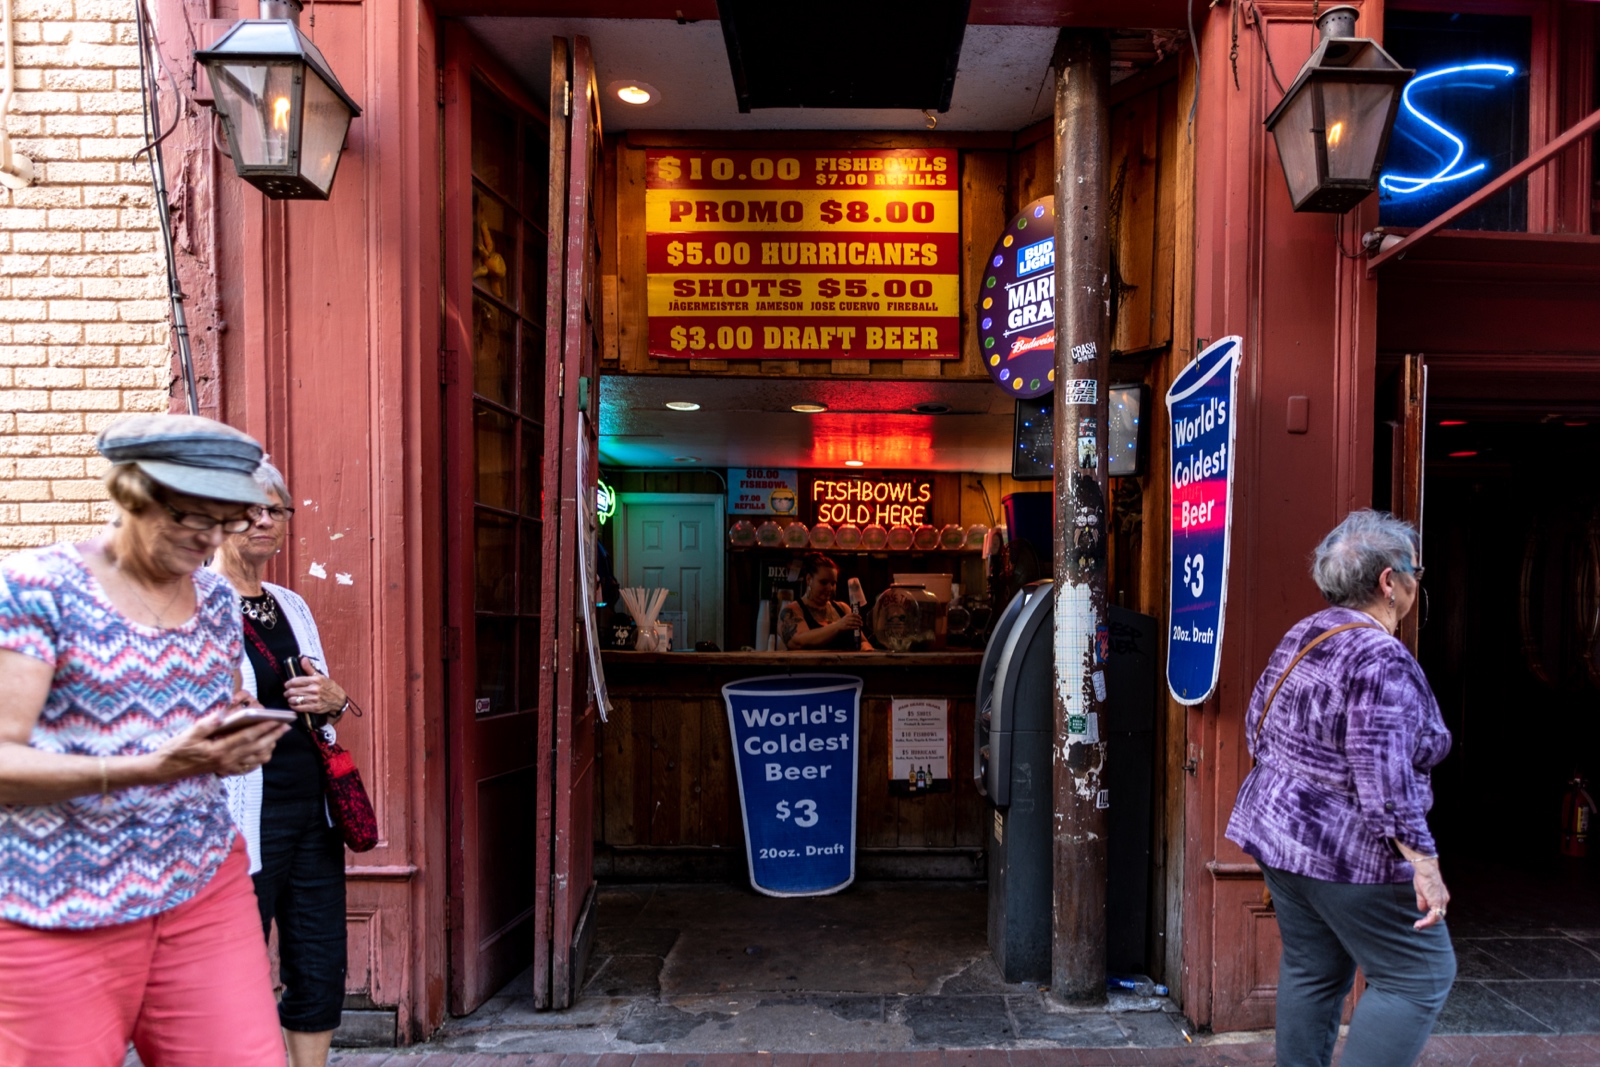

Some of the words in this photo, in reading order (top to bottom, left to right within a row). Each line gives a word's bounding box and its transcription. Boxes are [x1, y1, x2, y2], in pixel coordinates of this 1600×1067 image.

[658, 156, 800, 181] $10.00
[815, 157, 947, 172] FISHBOWLS
[816, 174, 868, 186] $7.00
[874, 174, 947, 186] REFILLS
[669, 200, 803, 223] PROMO
[820, 199, 935, 225] $8.00
[667, 240, 750, 267] $5.00
[761, 242, 938, 266] HURRICANES
[1025, 241, 1053, 261] BUD
[673, 278, 802, 298] SHOTS
[818, 277, 933, 299] $5.00
[756, 301, 803, 311] JAMESON
[810, 301, 836, 311] JOSE
[839, 301, 880, 311] CUERVO
[887, 302, 938, 311] FIREBALL
[1008, 299, 1055, 329] GRA
[670, 325, 753, 351] $3.00
[763, 326, 856, 350] DRAFT
[866, 326, 939, 350] BEER
[1071, 342, 1097, 360] CRASH
[1174, 397, 1226, 449] World's
[746, 469, 779, 479] $10.00
[1174, 443, 1226, 489] Coldest
[740, 480, 788, 489] FISHBOWL
[813, 479, 931, 503] FISHBOWLS
[818, 503, 870, 524] SOLD
[875, 504, 926, 526] HERE
[1182, 499, 1214, 528] Beer
[1183, 554, 1205, 598] $3
[1172, 626, 1191, 641] 20oz.
[1193, 627, 1214, 644] Draft
[742, 705, 847, 728] World's
[744, 733, 849, 755] Coldest
[765, 763, 832, 781] Beer
[775, 799, 819, 827] $3
[759, 848, 800, 859] 20oz.
[806, 844, 844, 856] Draft
